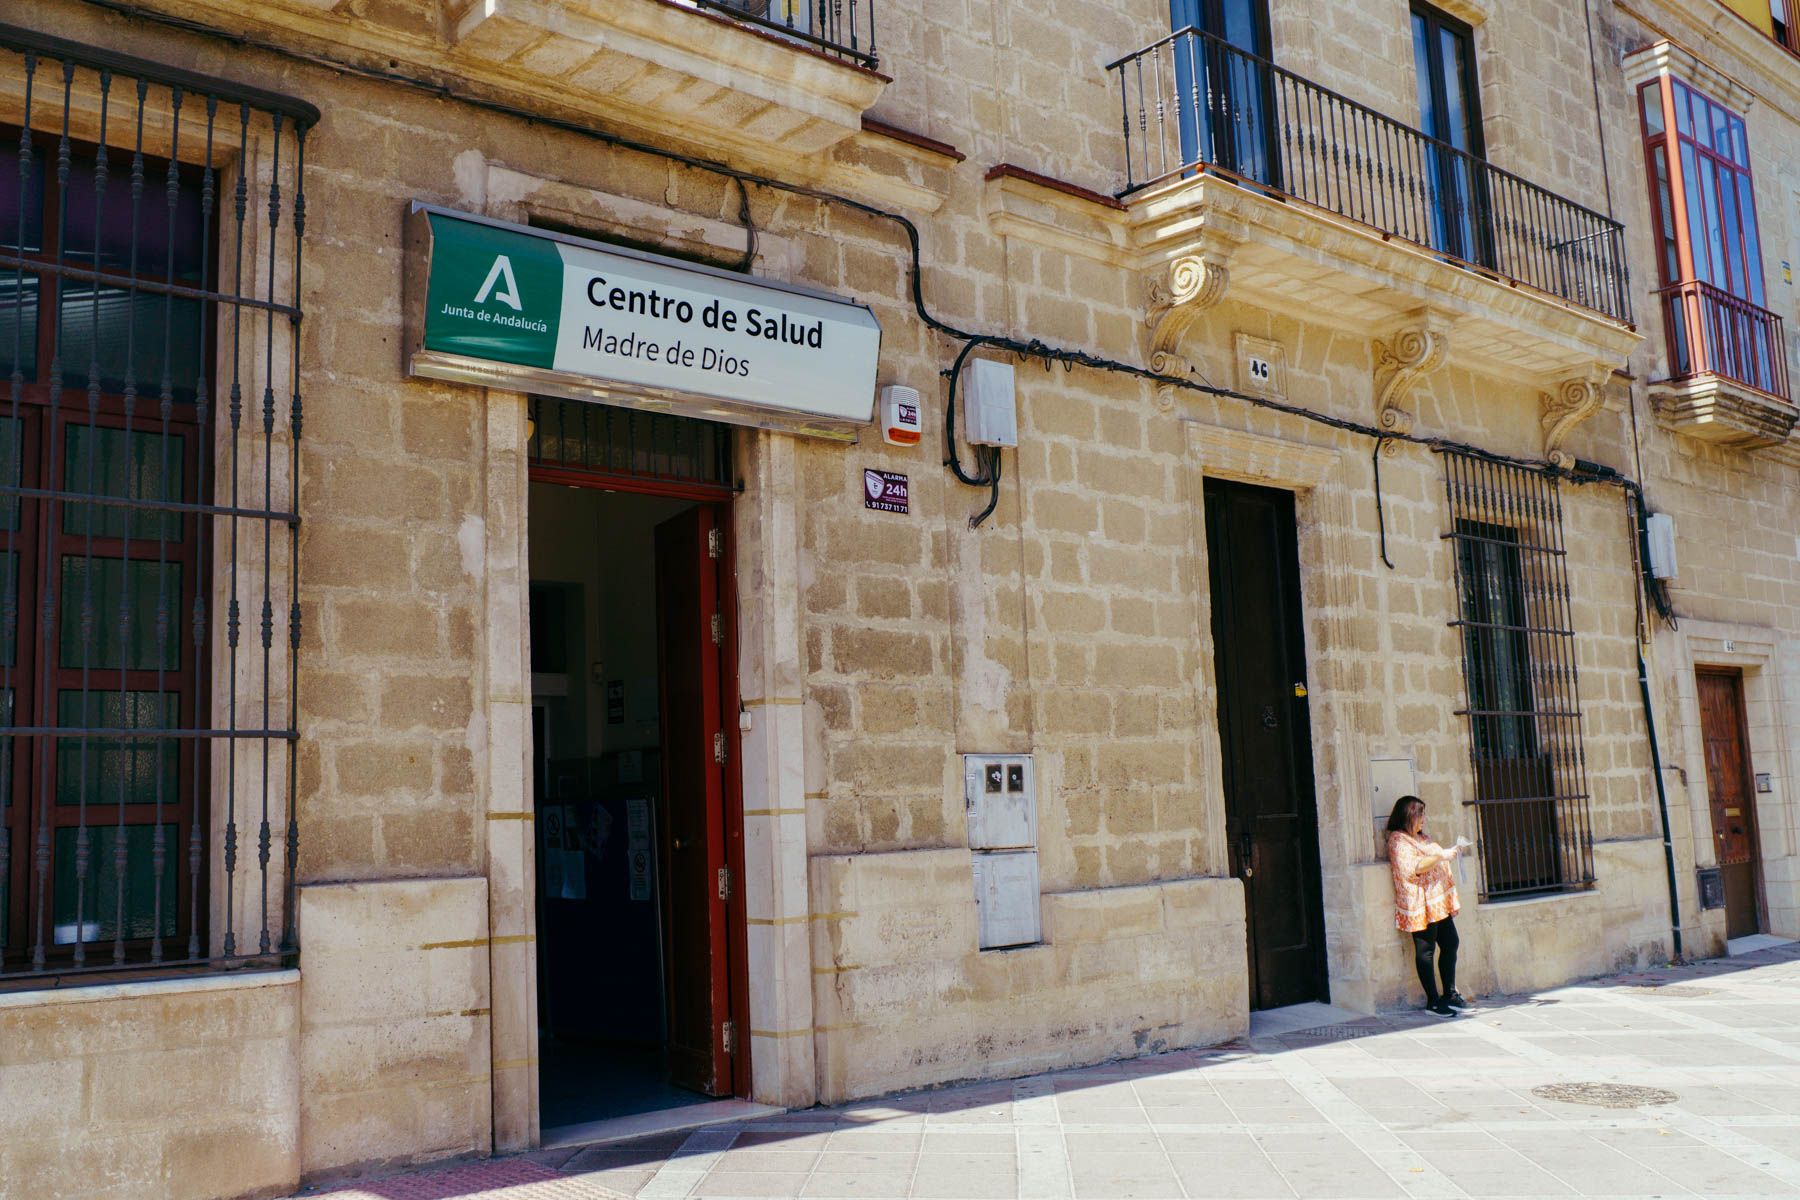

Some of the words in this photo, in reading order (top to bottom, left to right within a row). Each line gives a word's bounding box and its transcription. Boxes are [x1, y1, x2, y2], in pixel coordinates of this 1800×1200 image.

[441, 304, 474, 319] Junta
[477, 310, 491, 322] de
[493, 313, 547, 332] Andalucía
[587, 277, 693, 323] Centro
[702, 300, 737, 332] de
[746, 309, 823, 349] Salud
[583, 325, 660, 361] Madre
[666, 341, 695, 367] de
[701, 347, 750, 377] Dios
[1252, 360, 1268, 378] 46
[883, 473, 908, 482] ALARMA
[886, 483, 907, 497] 24h
[872, 501, 880, 509] 91
[880, 502, 893, 511] 737
